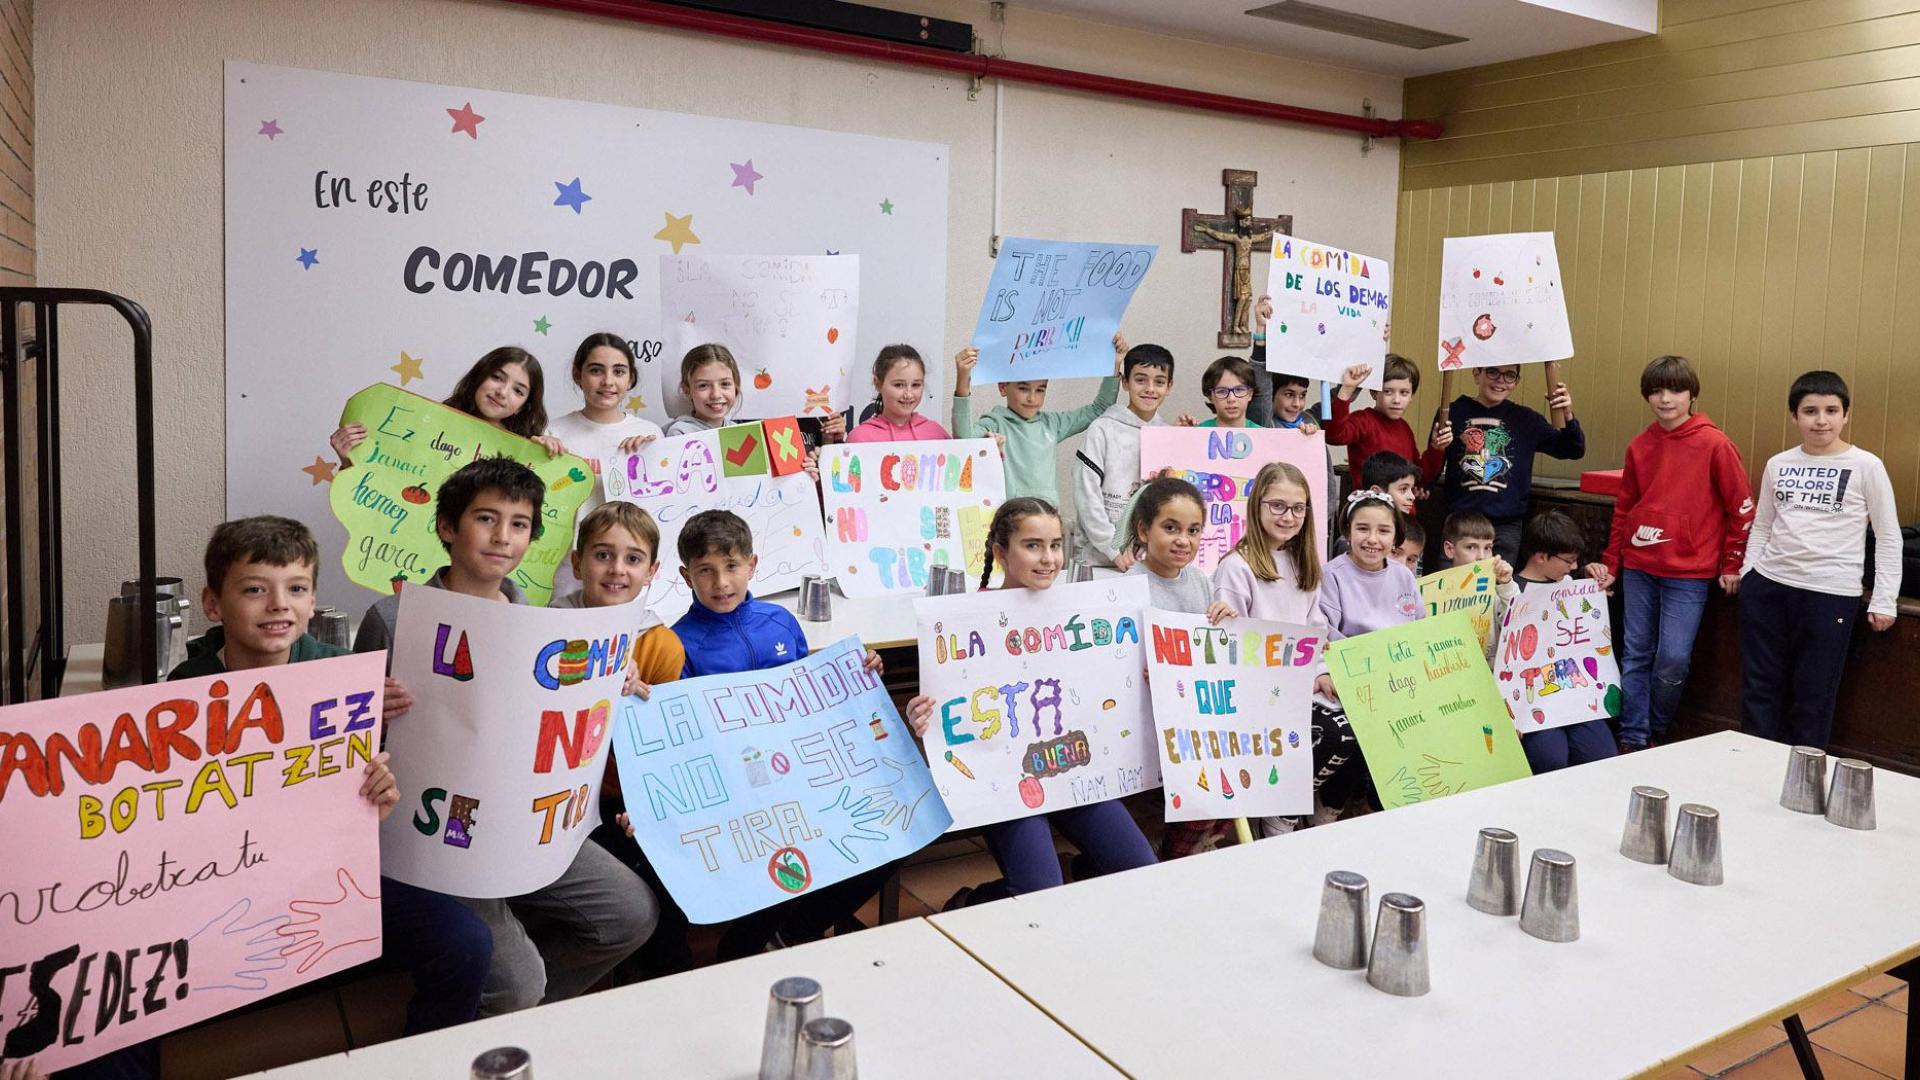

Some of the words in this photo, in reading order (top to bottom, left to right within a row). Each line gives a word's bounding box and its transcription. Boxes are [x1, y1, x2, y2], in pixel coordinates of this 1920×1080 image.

[314, 170, 357, 210] En
[368, 171, 429, 213] este
[1273, 239, 1292, 260] LA
[402, 245, 638, 299] COMEDOR
[1011, 251, 1069, 288] THE
[1074, 249, 1153, 290] FOOD
[1031, 287, 1083, 326] NOT
[1285, 271, 1304, 291] DE
[1315, 276, 1342, 299] LOS
[1349, 284, 1389, 310] DEMAS
[626, 339, 663, 363] aso
[376, 405, 416, 443] Ez
[430, 431, 462, 461] dago
[1207, 430, 1254, 460] NO
[831, 454, 862, 494] LA
[1776, 479, 1835, 491] COLORS
[1778, 467, 1839, 478] UNITED
[1210, 503, 1233, 526] LA
[1775, 490, 1795, 502] OF
[1800, 492, 1832, 505] THE
[836, 506, 869, 543] NO
[919, 505, 951, 540] SE
[1635, 524, 1665, 541] NIKE
[432, 622, 474, 682] LA
[1503, 623, 1539, 664] NO
[1555, 616, 1591, 646] SE
[308, 690, 376, 741] EZ
[941, 678, 1065, 746] ESTA
[1194, 680, 1238, 715] QUE
[533, 698, 612, 775] NO
[625, 693, 704, 757] LA
[641, 754, 730, 822] NO
[790, 719, 879, 788] SE
[1031, 738, 1089, 773] BUENA
[412, 787, 481, 850] SE
